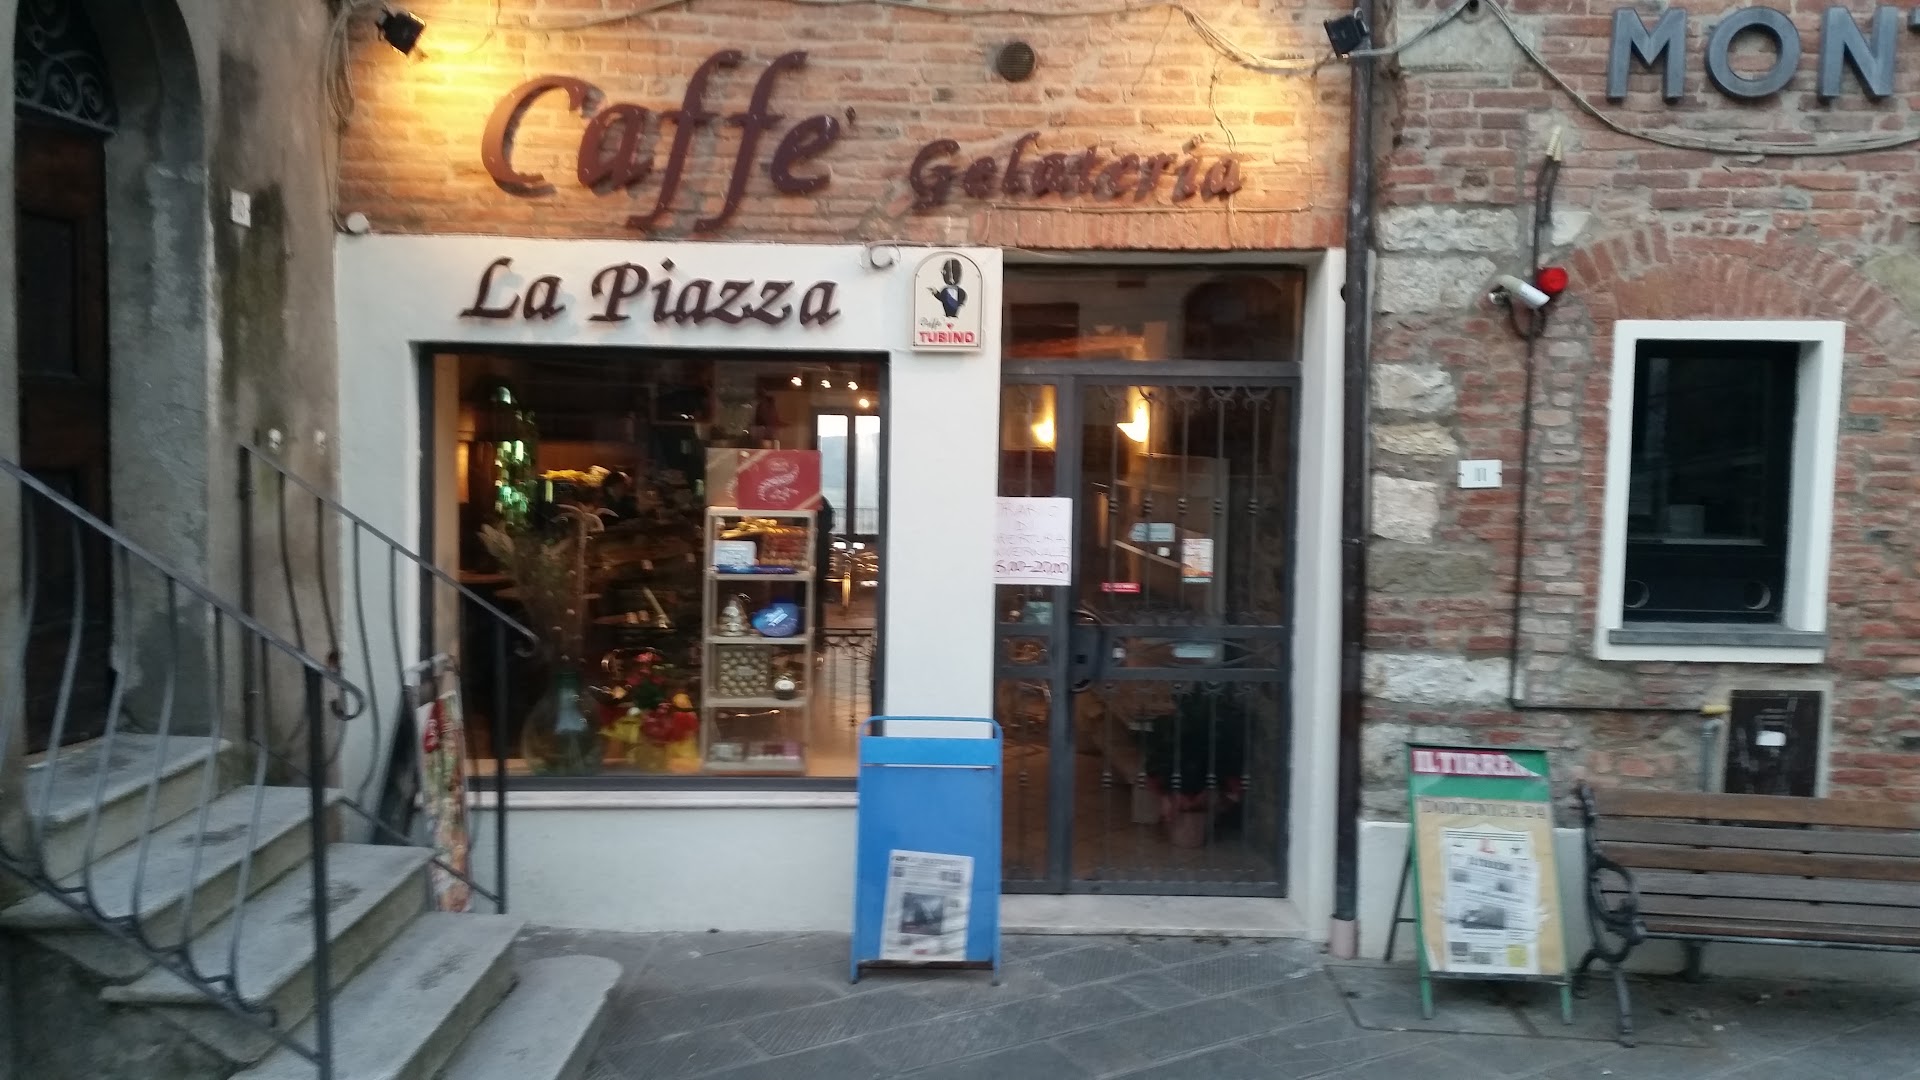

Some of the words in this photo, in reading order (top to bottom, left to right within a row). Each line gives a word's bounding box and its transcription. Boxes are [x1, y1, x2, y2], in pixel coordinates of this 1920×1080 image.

[1606, 6, 1920, 100] MON
[909, 131, 1246, 213] Gelateria
[458, 256, 567, 320] La
[588, 257, 841, 326] Piazza
[919, 331, 976, 344] TUBINO
